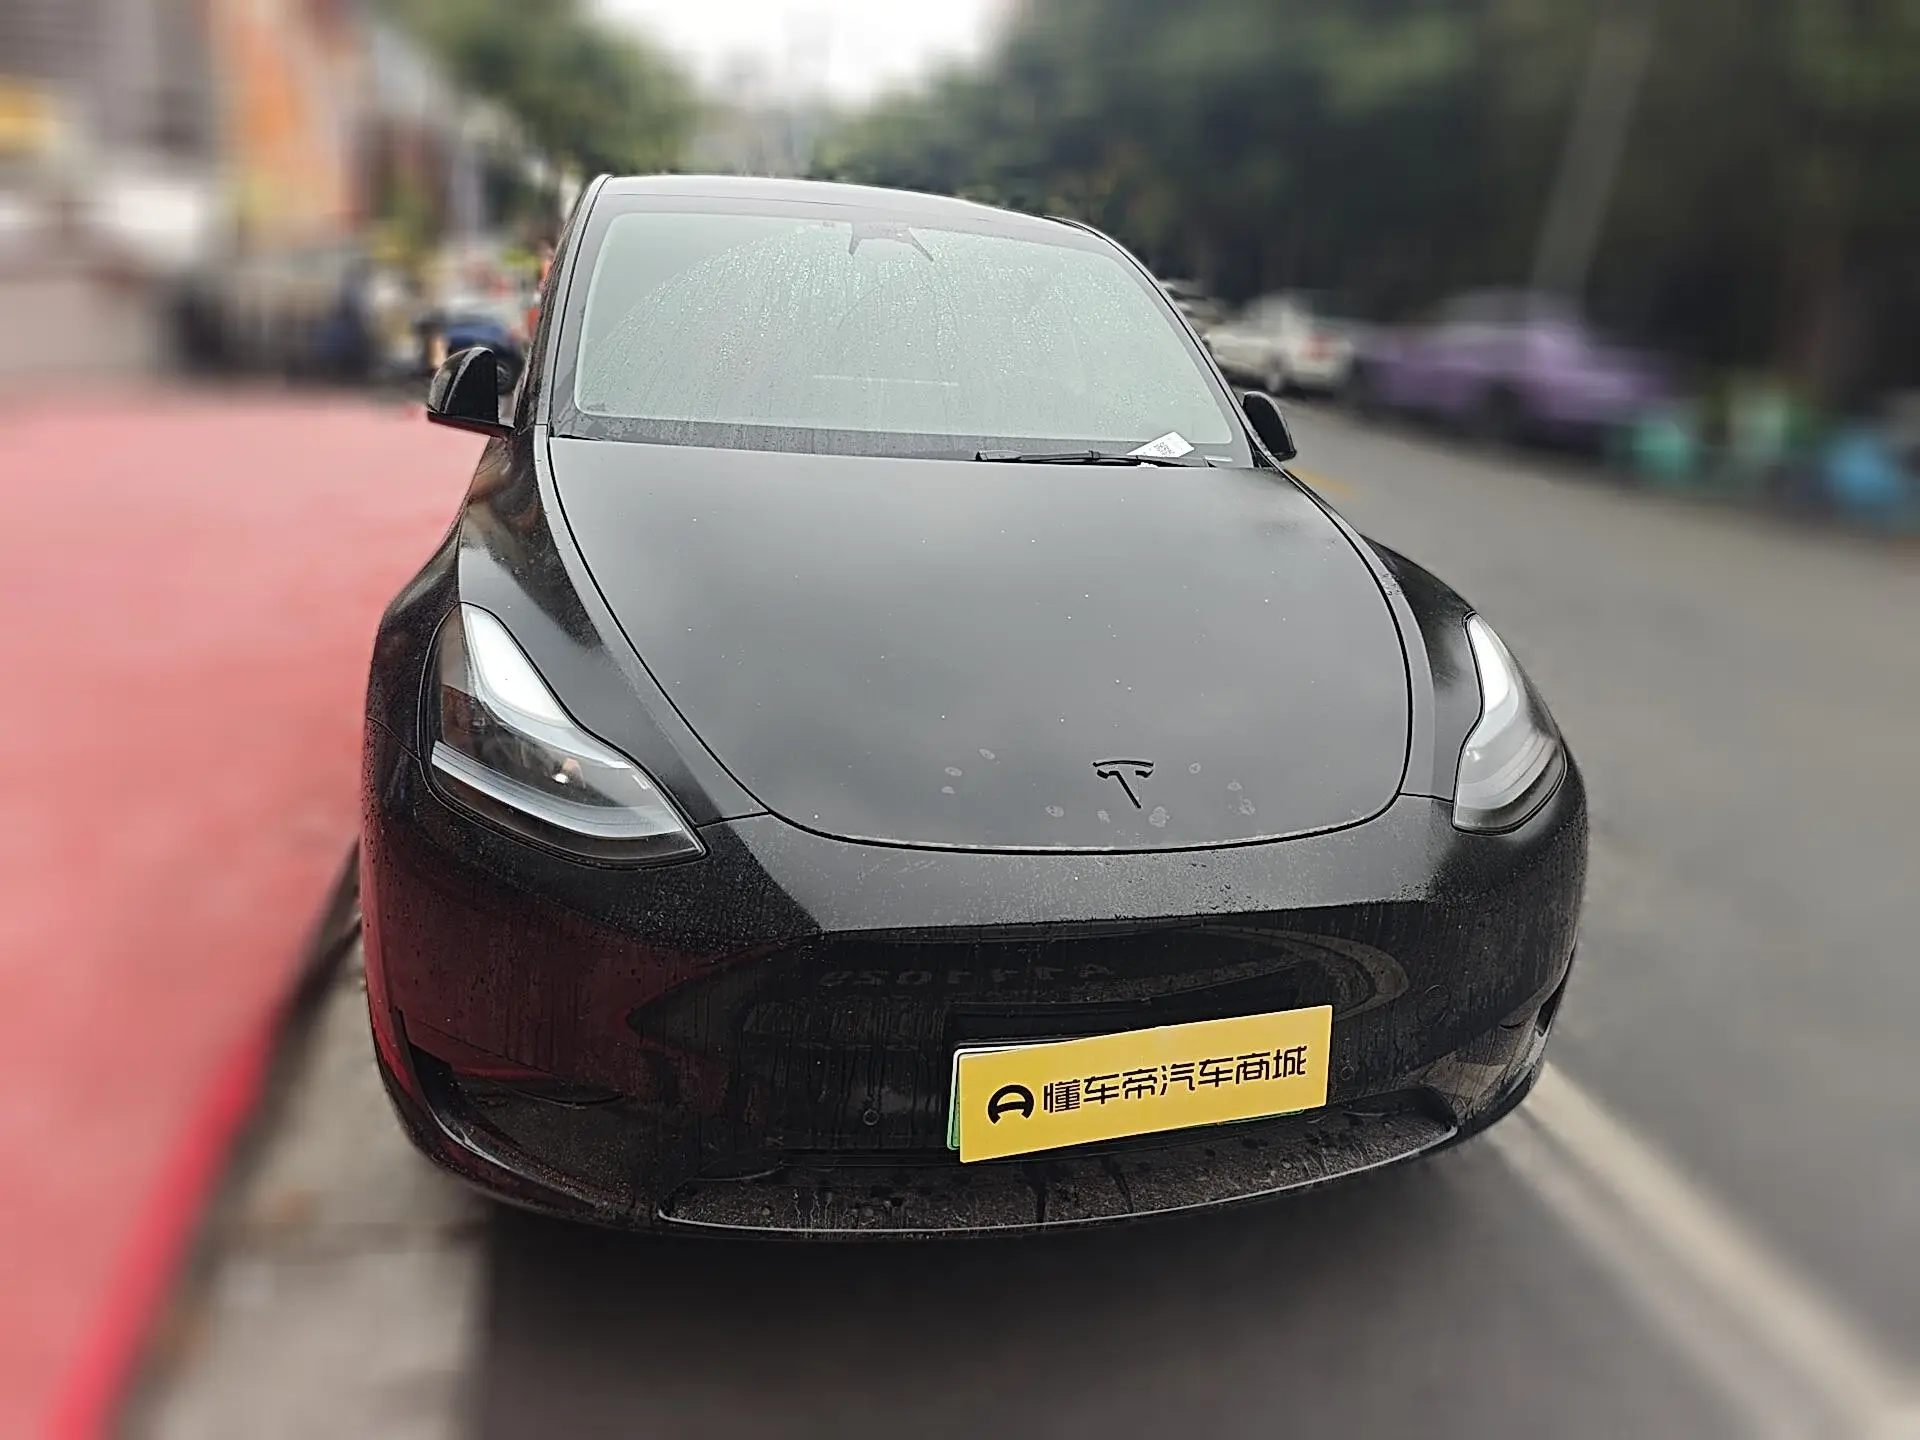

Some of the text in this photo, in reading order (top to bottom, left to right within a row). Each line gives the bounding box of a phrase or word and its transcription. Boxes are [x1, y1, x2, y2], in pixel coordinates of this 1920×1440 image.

[1043, 1045, 1308, 1113] 懂车帝汽车商城
